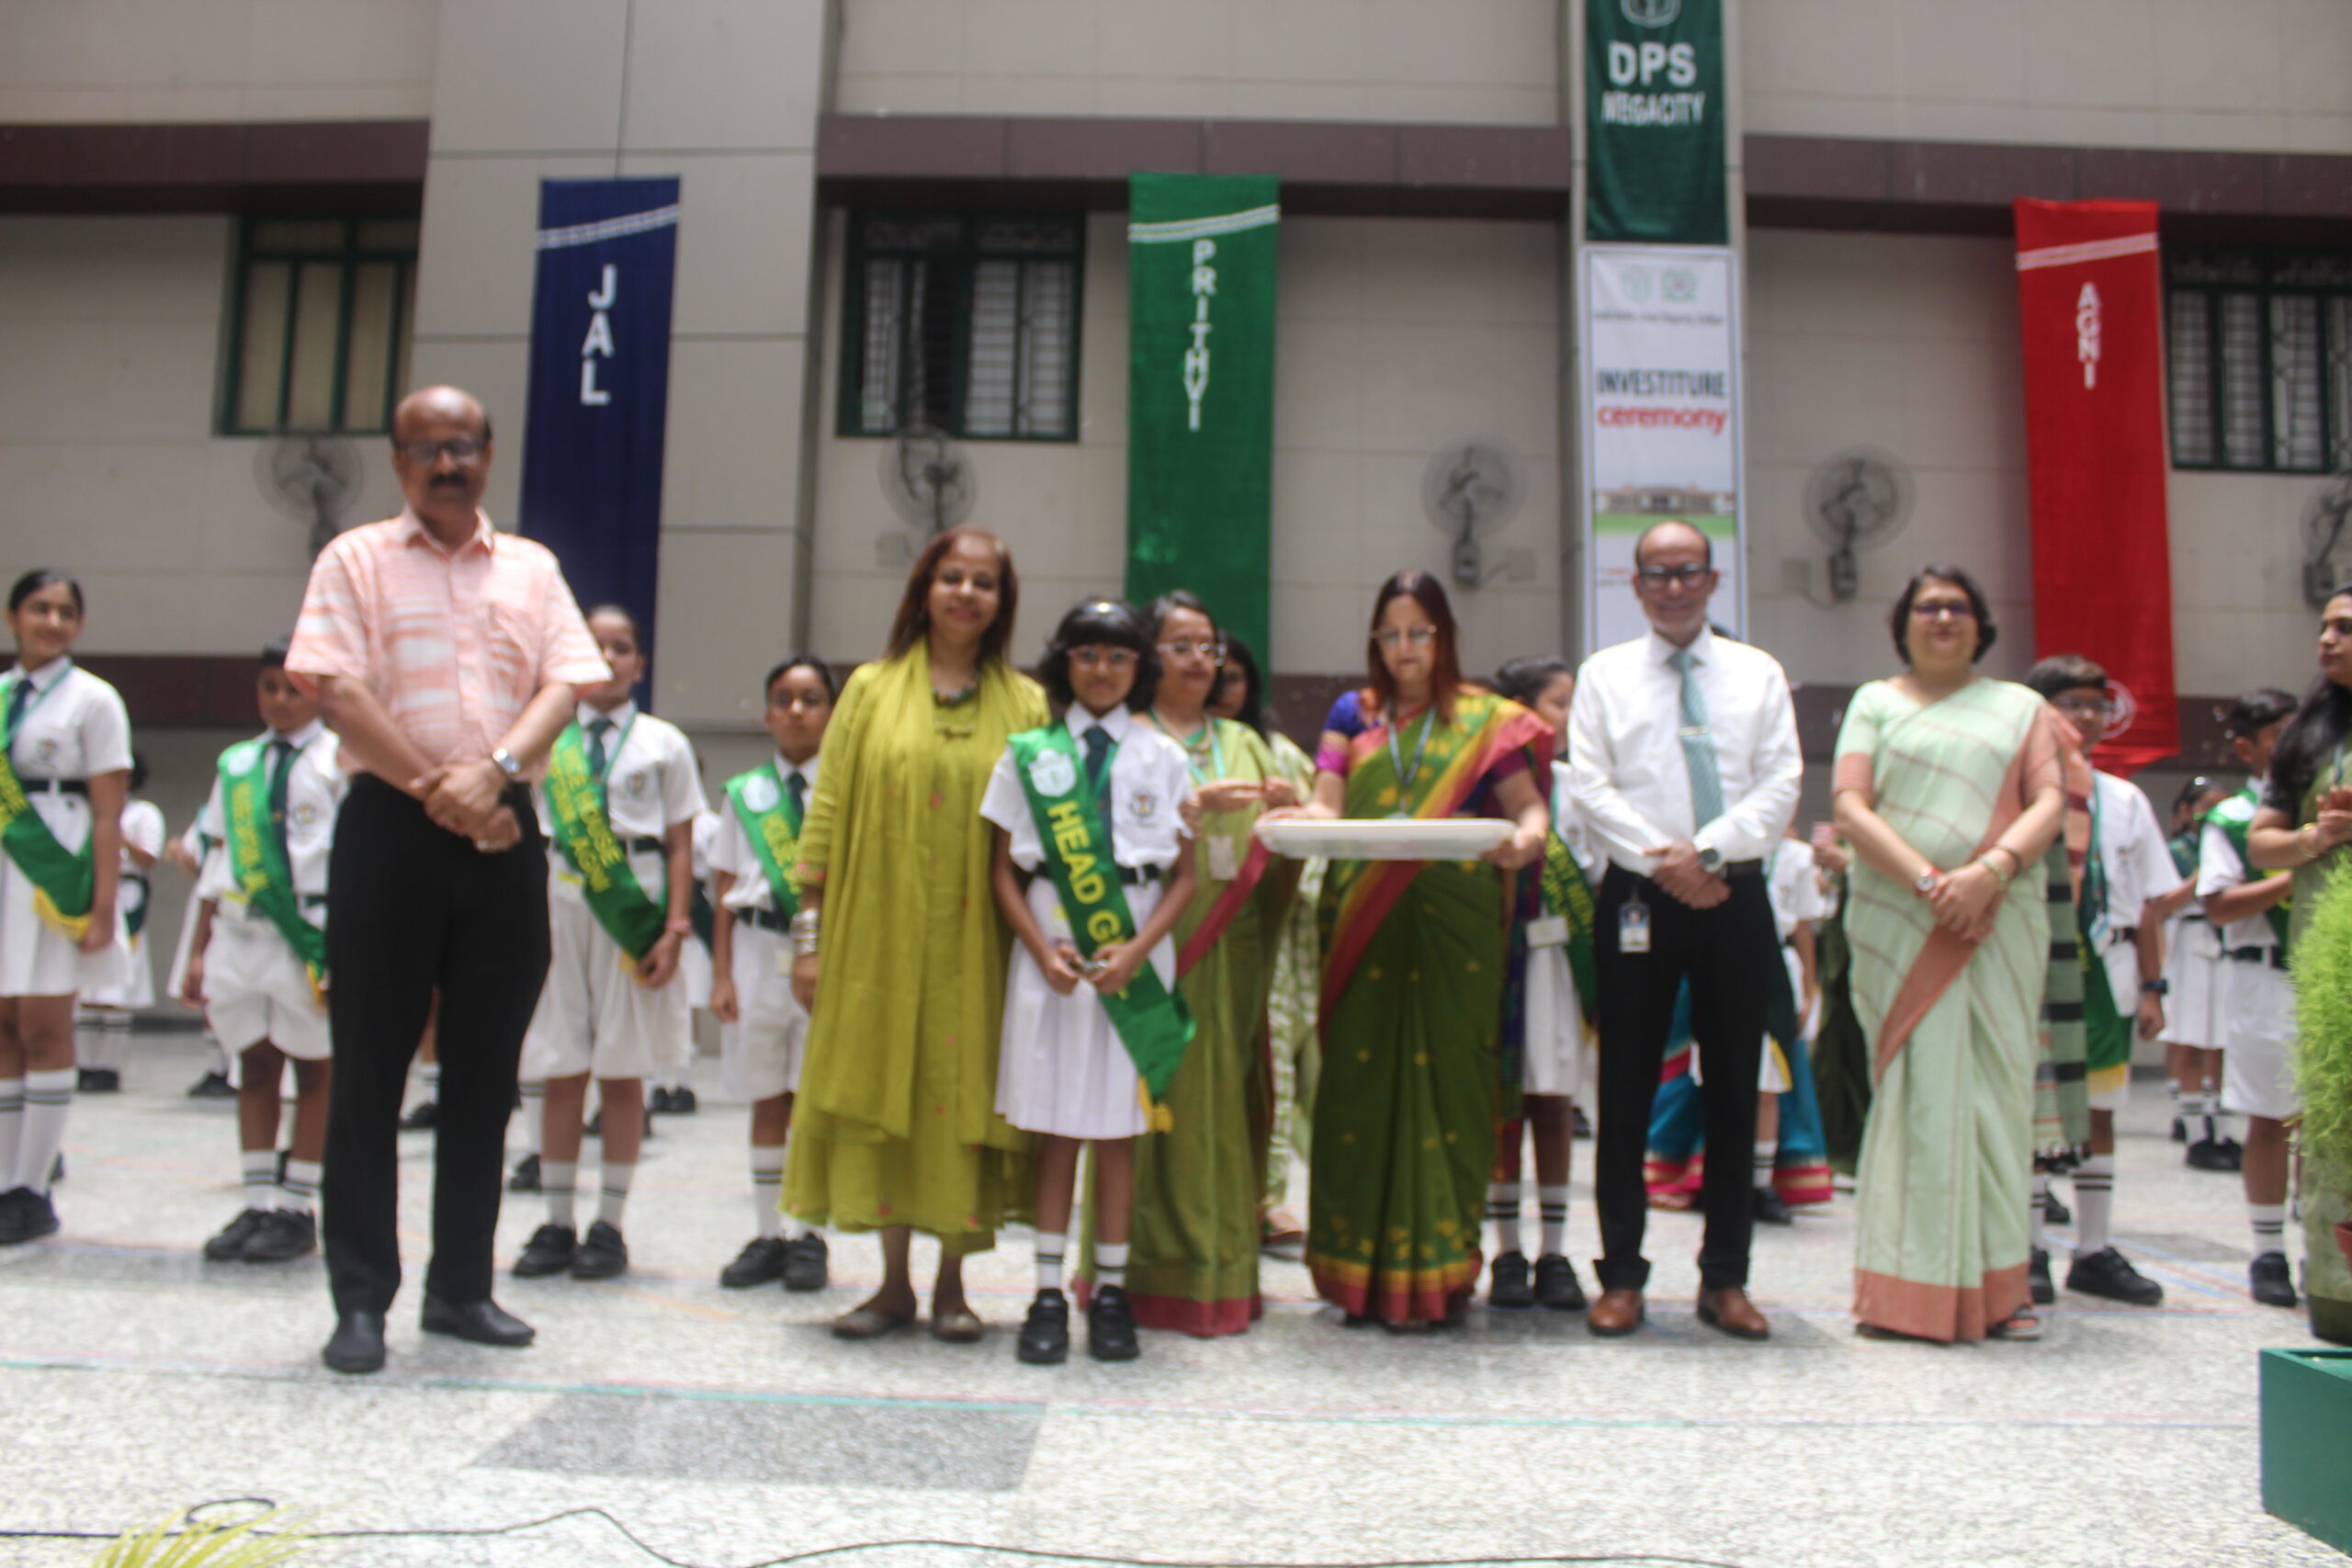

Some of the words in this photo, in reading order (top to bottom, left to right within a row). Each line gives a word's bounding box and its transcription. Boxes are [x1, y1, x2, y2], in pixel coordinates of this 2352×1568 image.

[1608, 41, 1697, 86] DPS
[1601, 92, 1705, 126] MEGACITY
[581, 264, 616, 405] JAL
[1183, 239, 1217, 432] PRITHVI
[2075, 281, 2101, 389] AGNI
[1597, 368, 1726, 398] INVESTITURE
[1597, 404, 1727, 435] ceremony
[1046, 800, 1106, 905] HEAD
